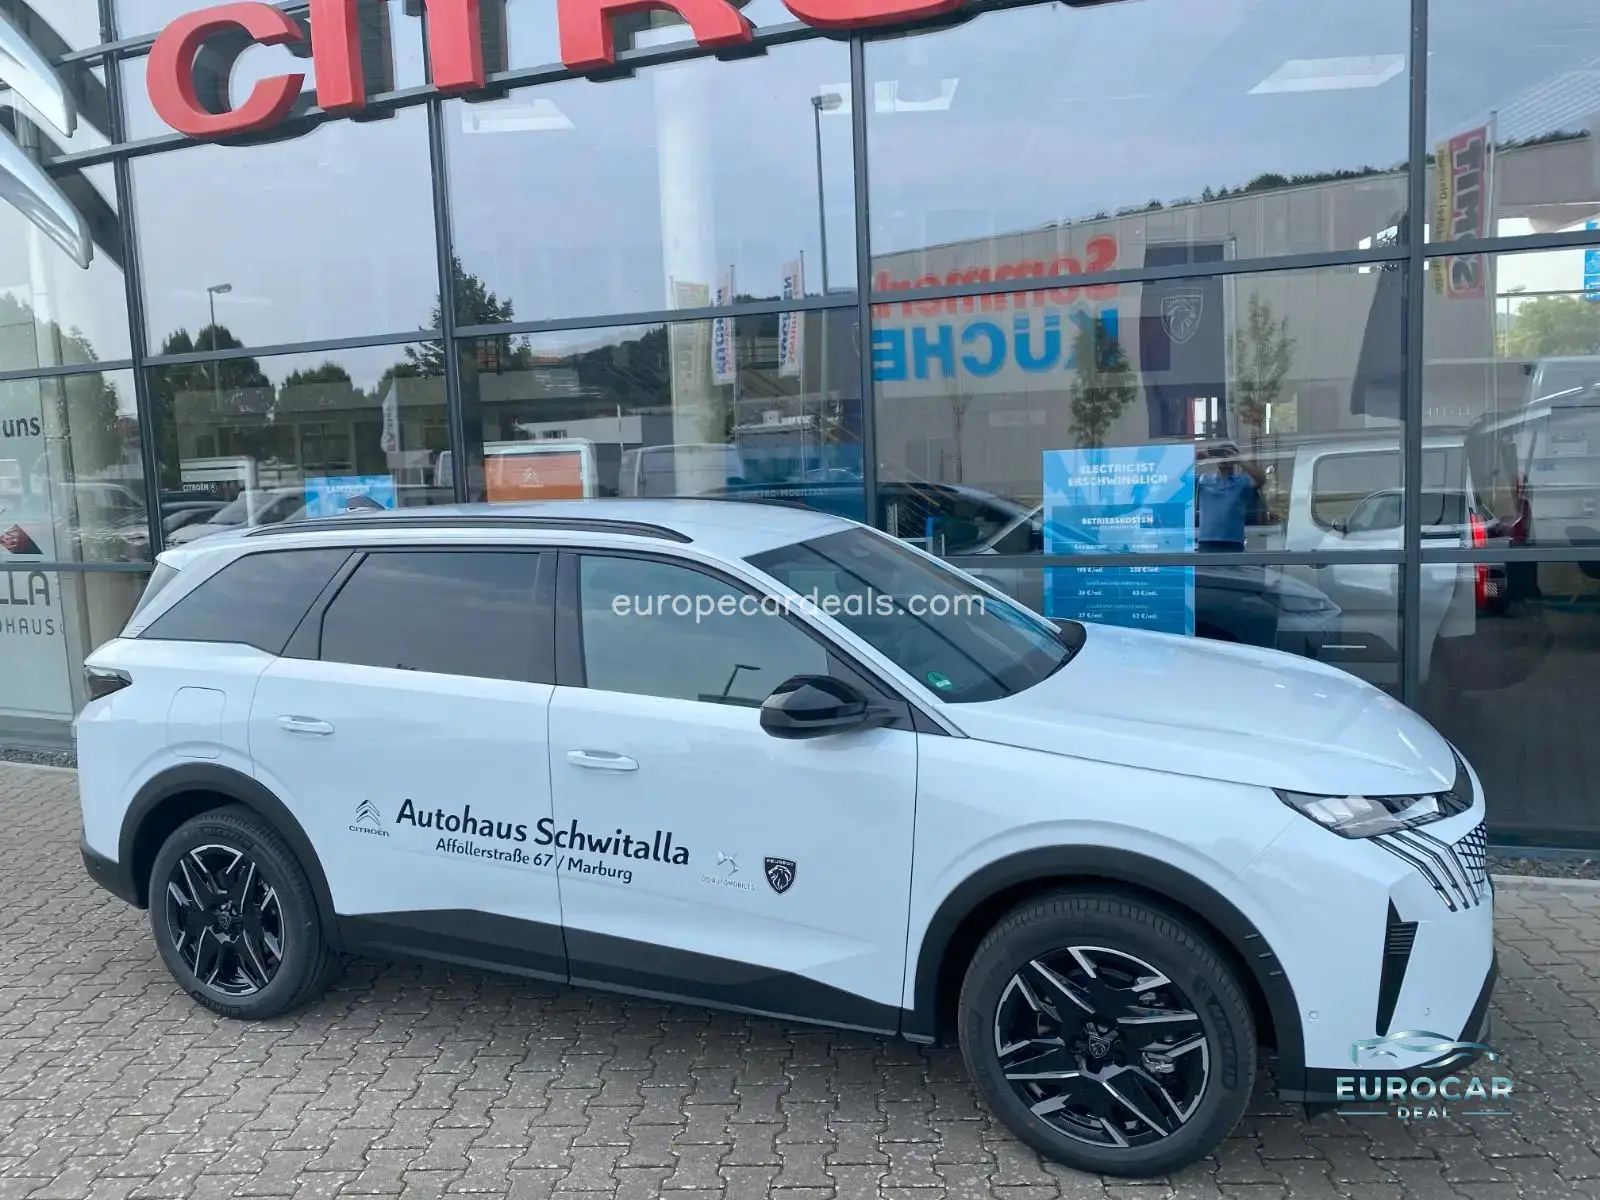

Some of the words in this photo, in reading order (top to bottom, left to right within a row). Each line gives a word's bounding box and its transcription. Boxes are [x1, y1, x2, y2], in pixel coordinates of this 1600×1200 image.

[2, 416, 41, 438] uns
[1079, 463, 1136, 475] ELECTRIC
[1137, 462, 1156, 473] IST
[1068, 474, 1168, 487] ERSCHWINGLICH
[1081, 516, 1154, 526] BETRIEBSKOSTEN
[395, 798, 528, 843] Autohaus
[534, 817, 691, 865] Schwitalla
[436, 838, 530, 866] Afföllerstraße
[533, 853, 553, 868] 67
[567, 857, 633, 884] Marburg
